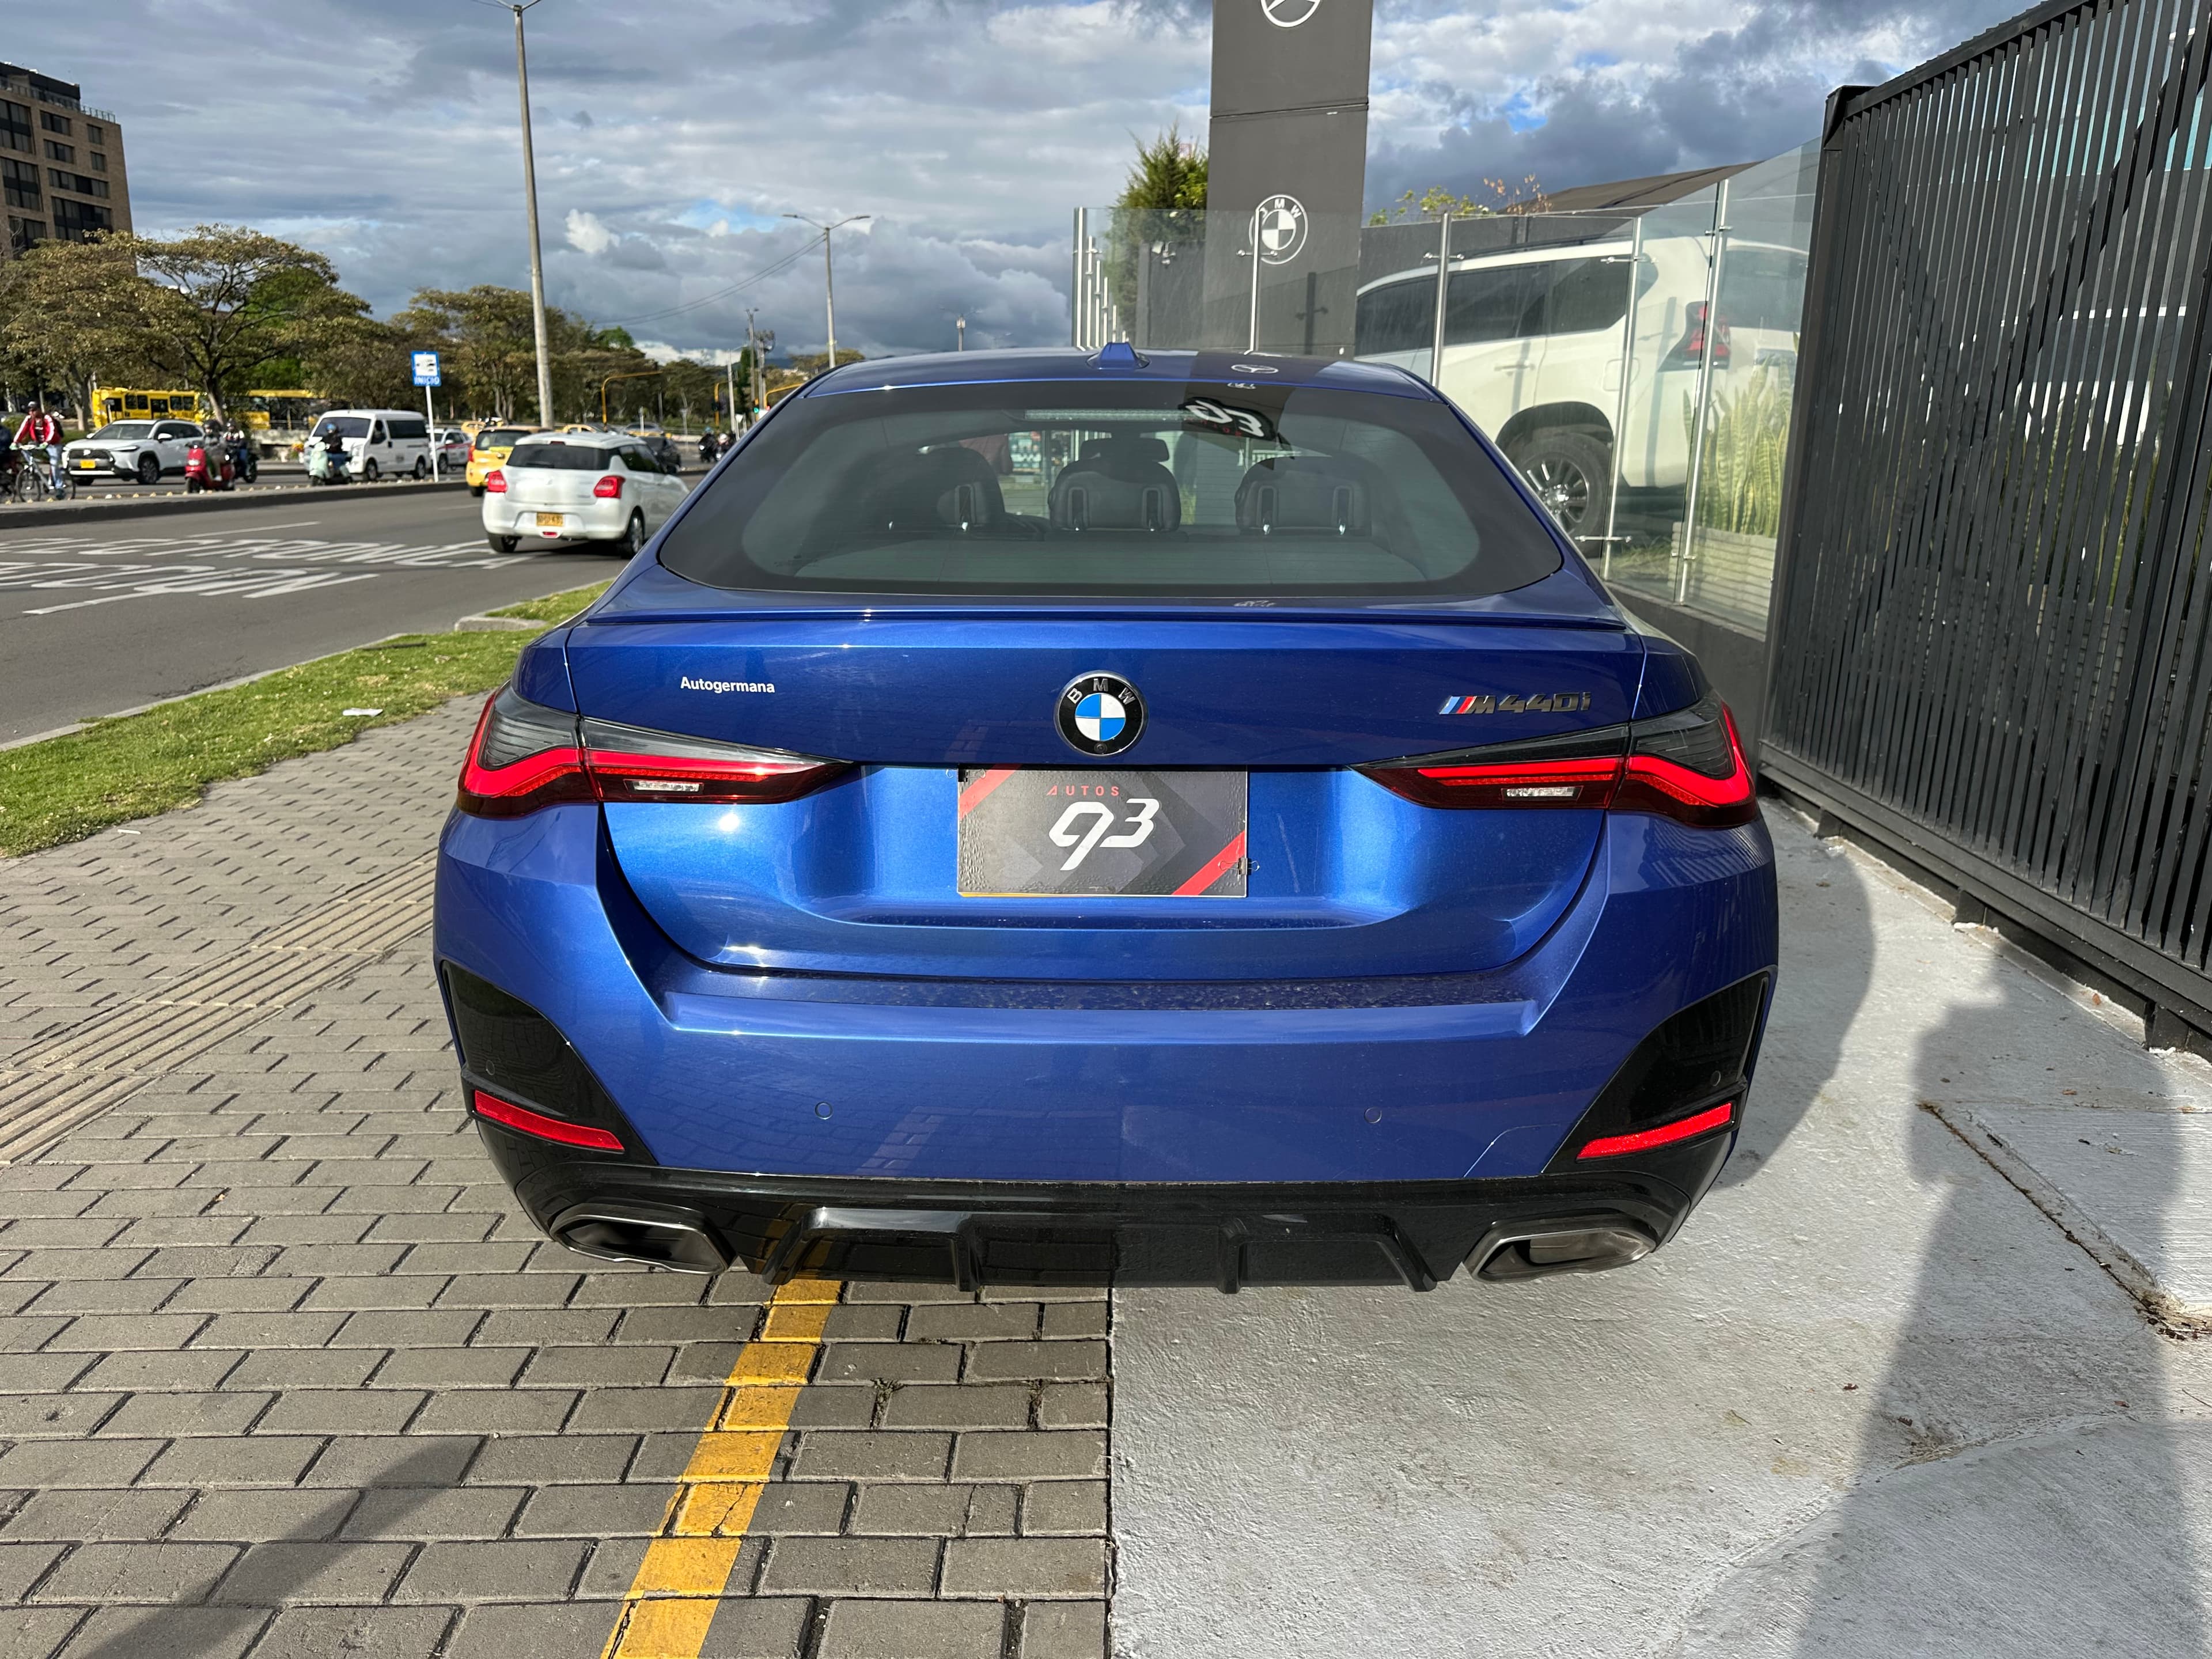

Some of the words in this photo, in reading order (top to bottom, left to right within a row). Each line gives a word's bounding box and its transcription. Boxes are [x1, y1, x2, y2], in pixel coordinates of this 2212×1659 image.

[414, 376, 440, 385] INICIO
[680, 676, 775, 694] Autogermana
[1067, 677, 1136, 704] BMW
[1046, 785, 1120, 796] AUTOS
[1048, 798, 1160, 870] 93
